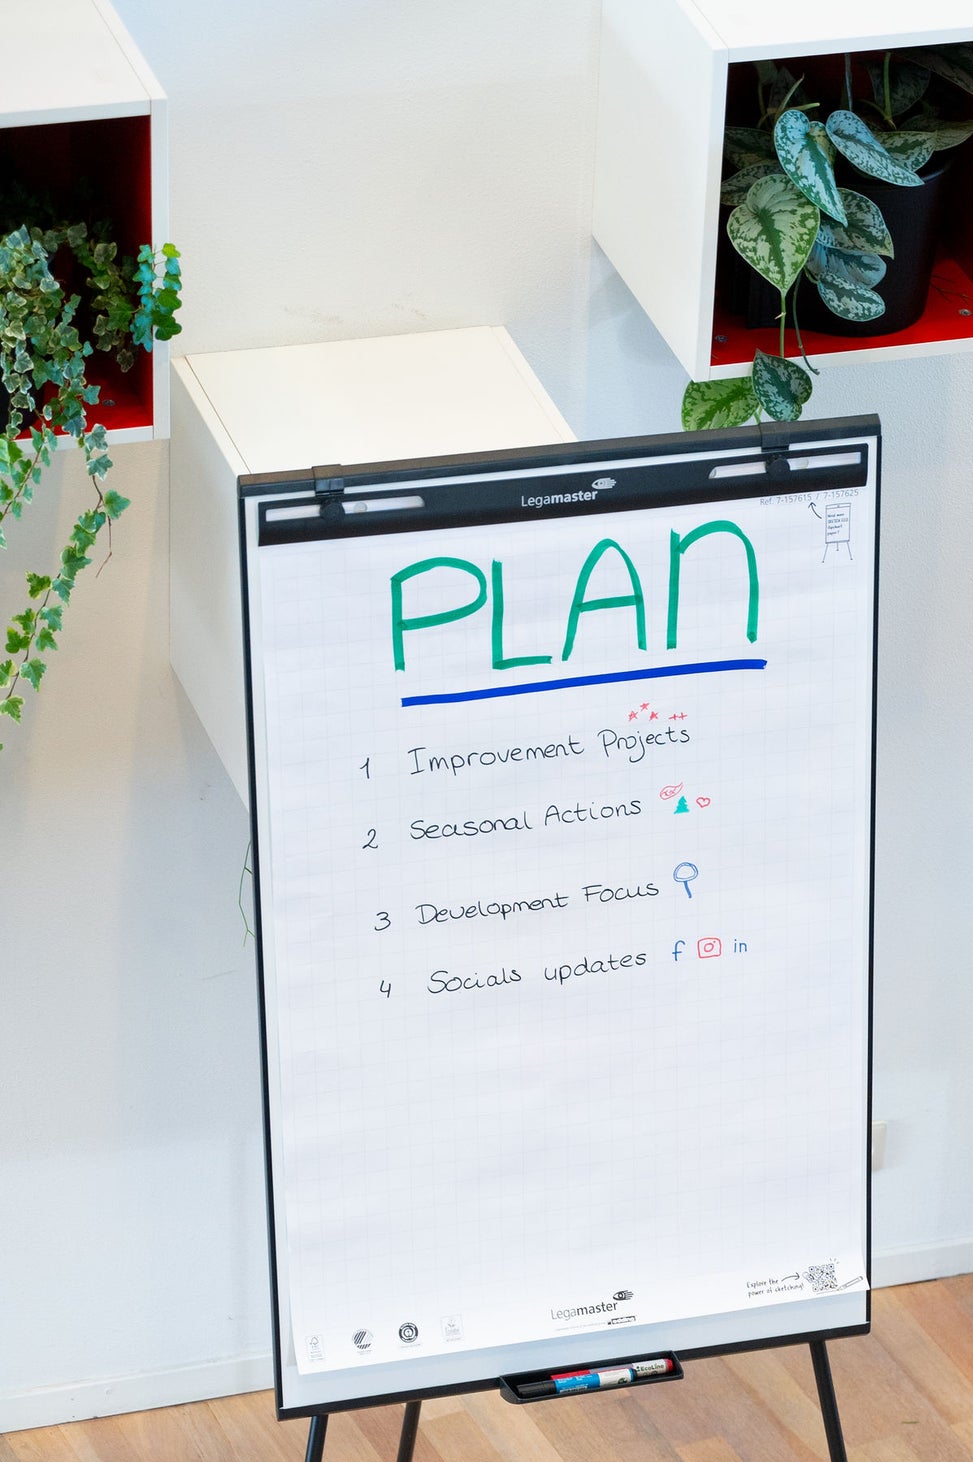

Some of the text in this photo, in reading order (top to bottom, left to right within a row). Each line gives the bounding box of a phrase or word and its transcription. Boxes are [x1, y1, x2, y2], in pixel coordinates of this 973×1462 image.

[521, 490, 598, 508] Legamaster
[776, 494, 812, 505] 7-157615
[823, 489, 860, 499] 7-157625
[390, 519, 760, 672] PLAN
[359, 725, 691, 780] 1 Improvement Projects
[362, 799, 643, 851] 2 Seasonal Actions
[374, 882, 660, 932] 3 Development Focus
[379, 979, 393, 999] 4
[427, 967, 523, 995] Socials
[544, 952, 648, 987] updates
[746, 1277, 779, 1289] Explore the
[748, 1290, 764, 1298] power
[550, 1301, 618, 1321] Legamaster
[640, 1363, 664, 1372] EcoLine
